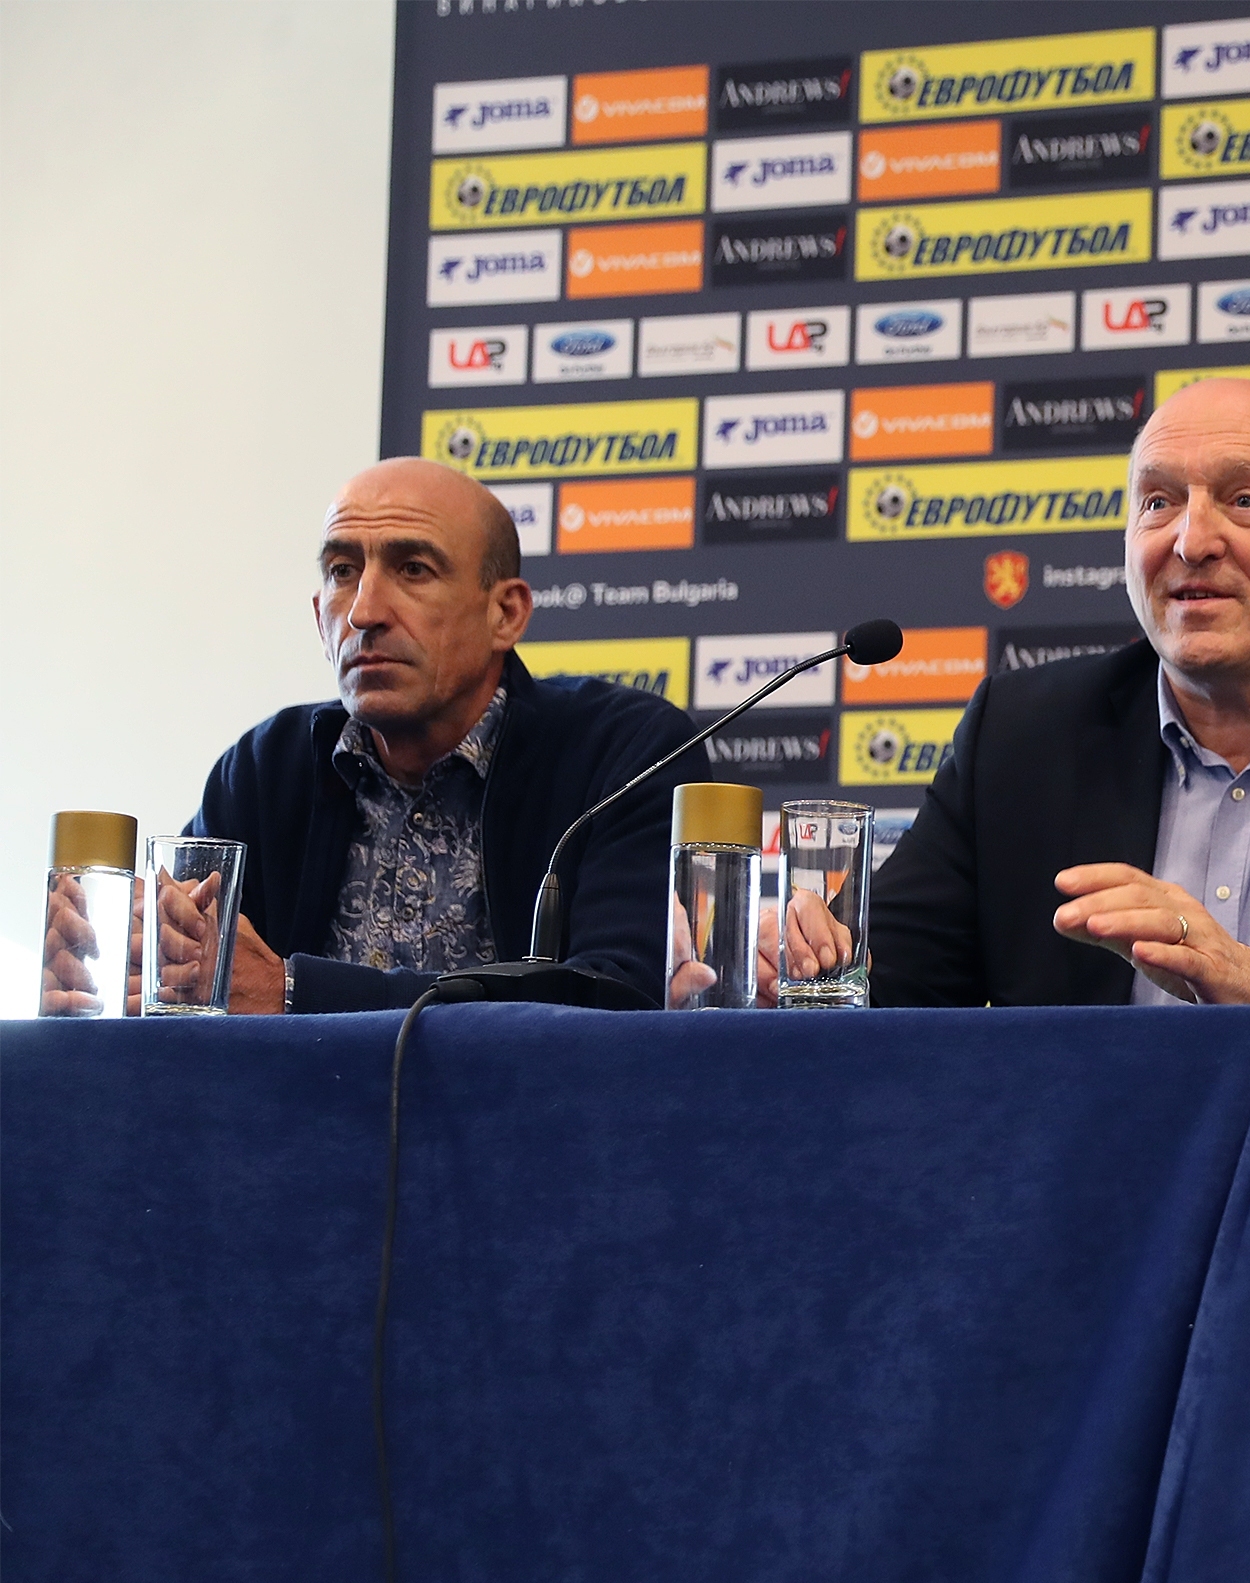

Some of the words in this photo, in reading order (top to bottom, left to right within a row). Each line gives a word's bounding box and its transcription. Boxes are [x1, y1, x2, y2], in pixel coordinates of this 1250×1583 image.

[917, 62, 1135, 109] ЕВРОФУТБОЛ
[602, 95, 706, 119] VIVACOM
[890, 149, 999, 174] VIVACOM
[483, 176, 686, 216] ЕВРОФУТБОЛ
[599, 248, 702, 272] VIVACOM
[912, 223, 1132, 267] ЕВРОФУТБОЛ
[882, 411, 991, 434] VIVACOM
[474, 431, 679, 470] ЕВРОФУТБОЛ
[587, 505, 692, 527] VIVACOM
[905, 488, 1123, 529] ЕВРОФУТБОЛ
[652, 577, 739, 607] Bulgaria
